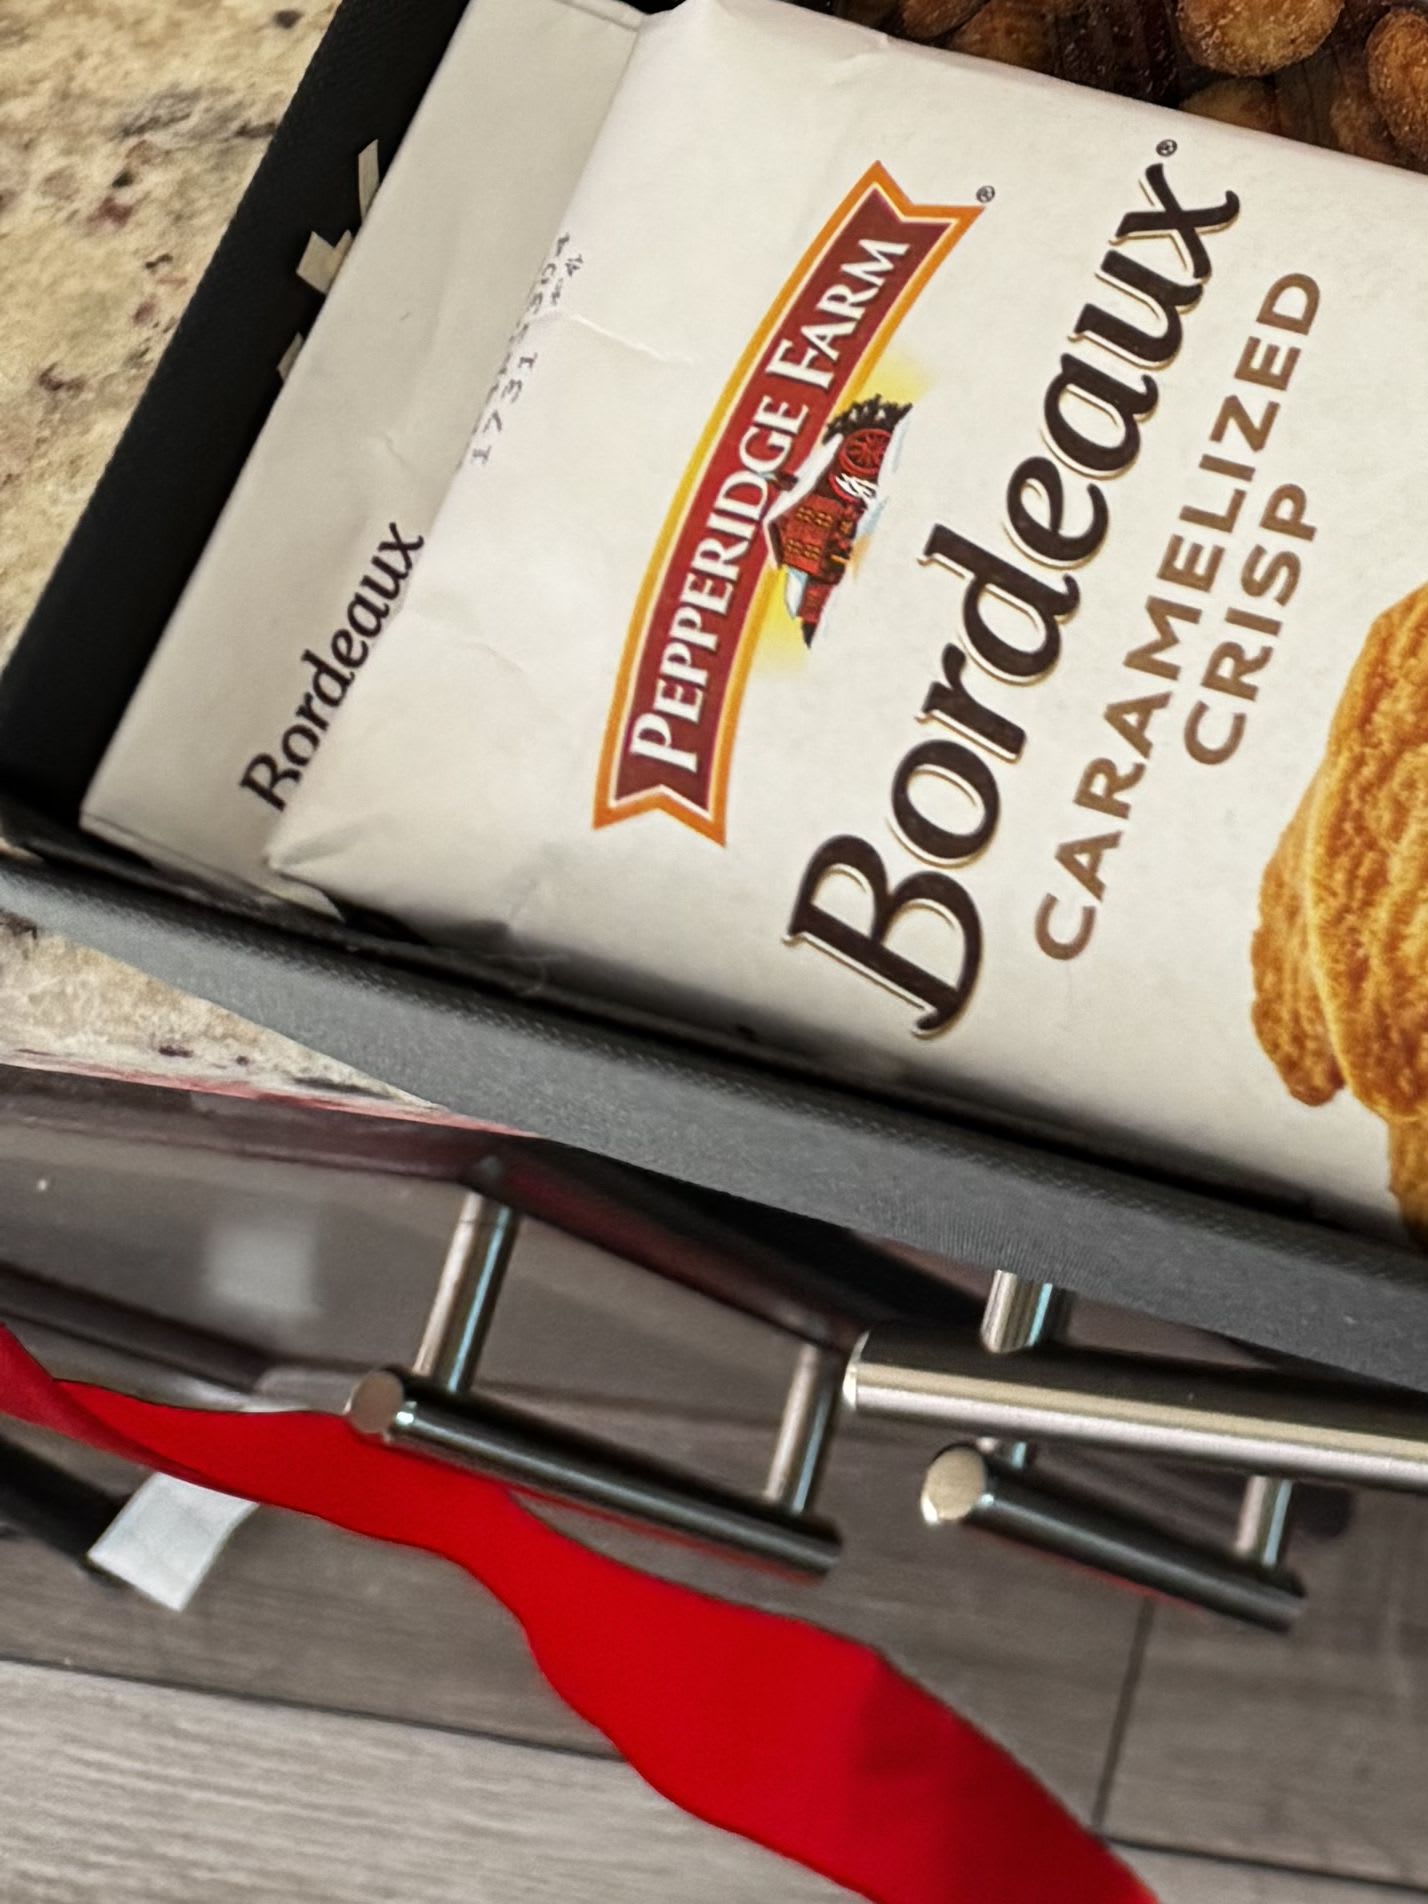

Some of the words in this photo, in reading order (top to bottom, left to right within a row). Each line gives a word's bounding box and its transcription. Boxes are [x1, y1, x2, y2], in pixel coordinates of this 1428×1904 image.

[239, 520, 424, 812] Bordeaux
[630, 395, 810, 773] PEPPERIDGE
[766, 237, 912, 391] FARM
[1034, 272, 1322, 961] CARAMELIZED
[1184, 483, 1317, 766] CRISP
